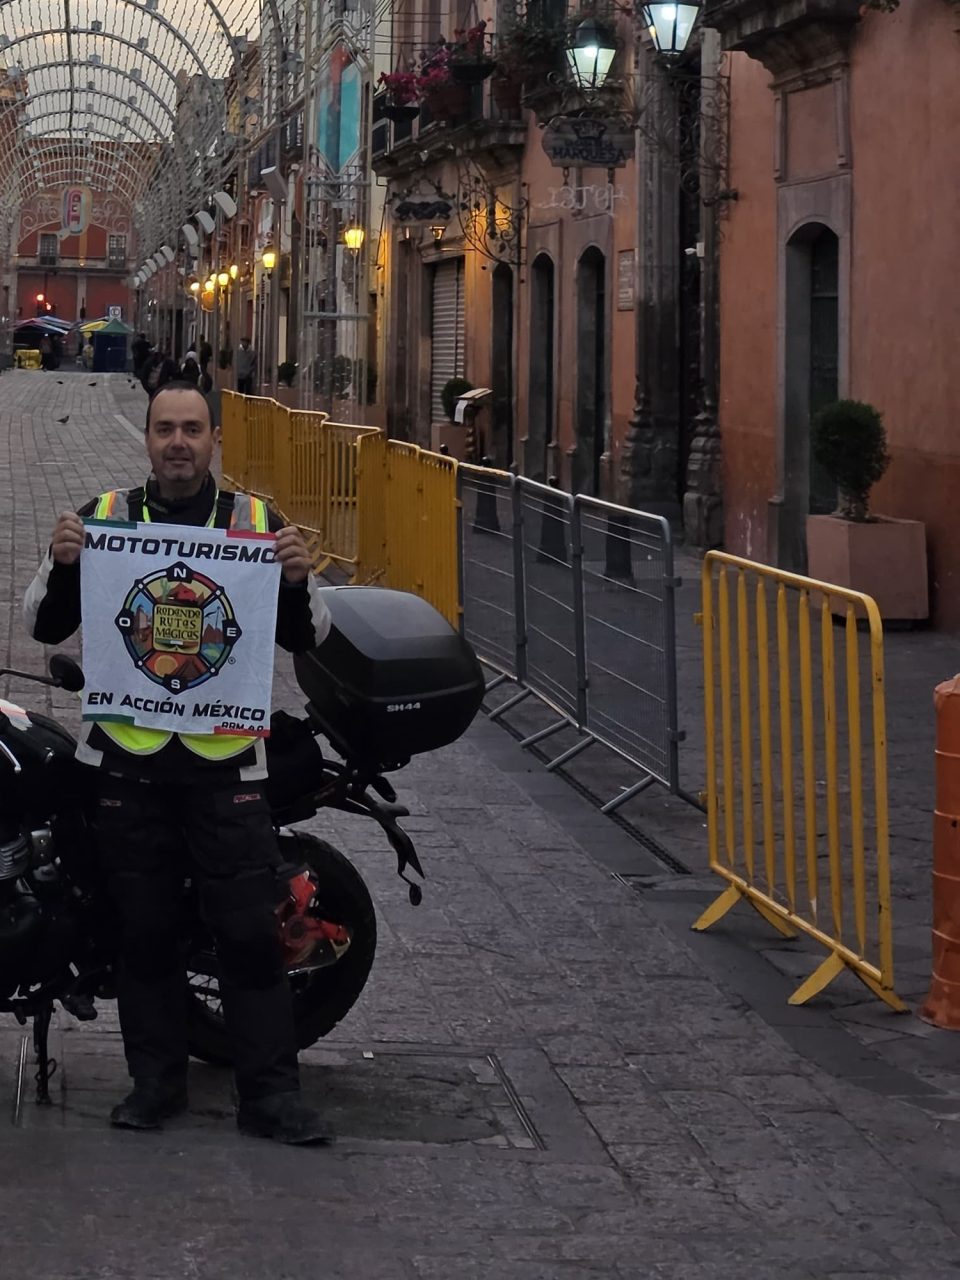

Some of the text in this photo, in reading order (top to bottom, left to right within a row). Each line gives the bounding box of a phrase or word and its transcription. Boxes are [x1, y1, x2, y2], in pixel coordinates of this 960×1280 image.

[552, 146, 626, 161] MARQUESA
[84, 532, 277, 564] MOTOTURISMO
[173, 568, 187, 578] N
[119, 617, 130, 627] O
[227, 627, 237, 637] E
[170, 679, 180, 689] S
[87, 692, 265, 722] EN ACCIÓN MÉXICO
[386, 702, 421, 712] SH44
